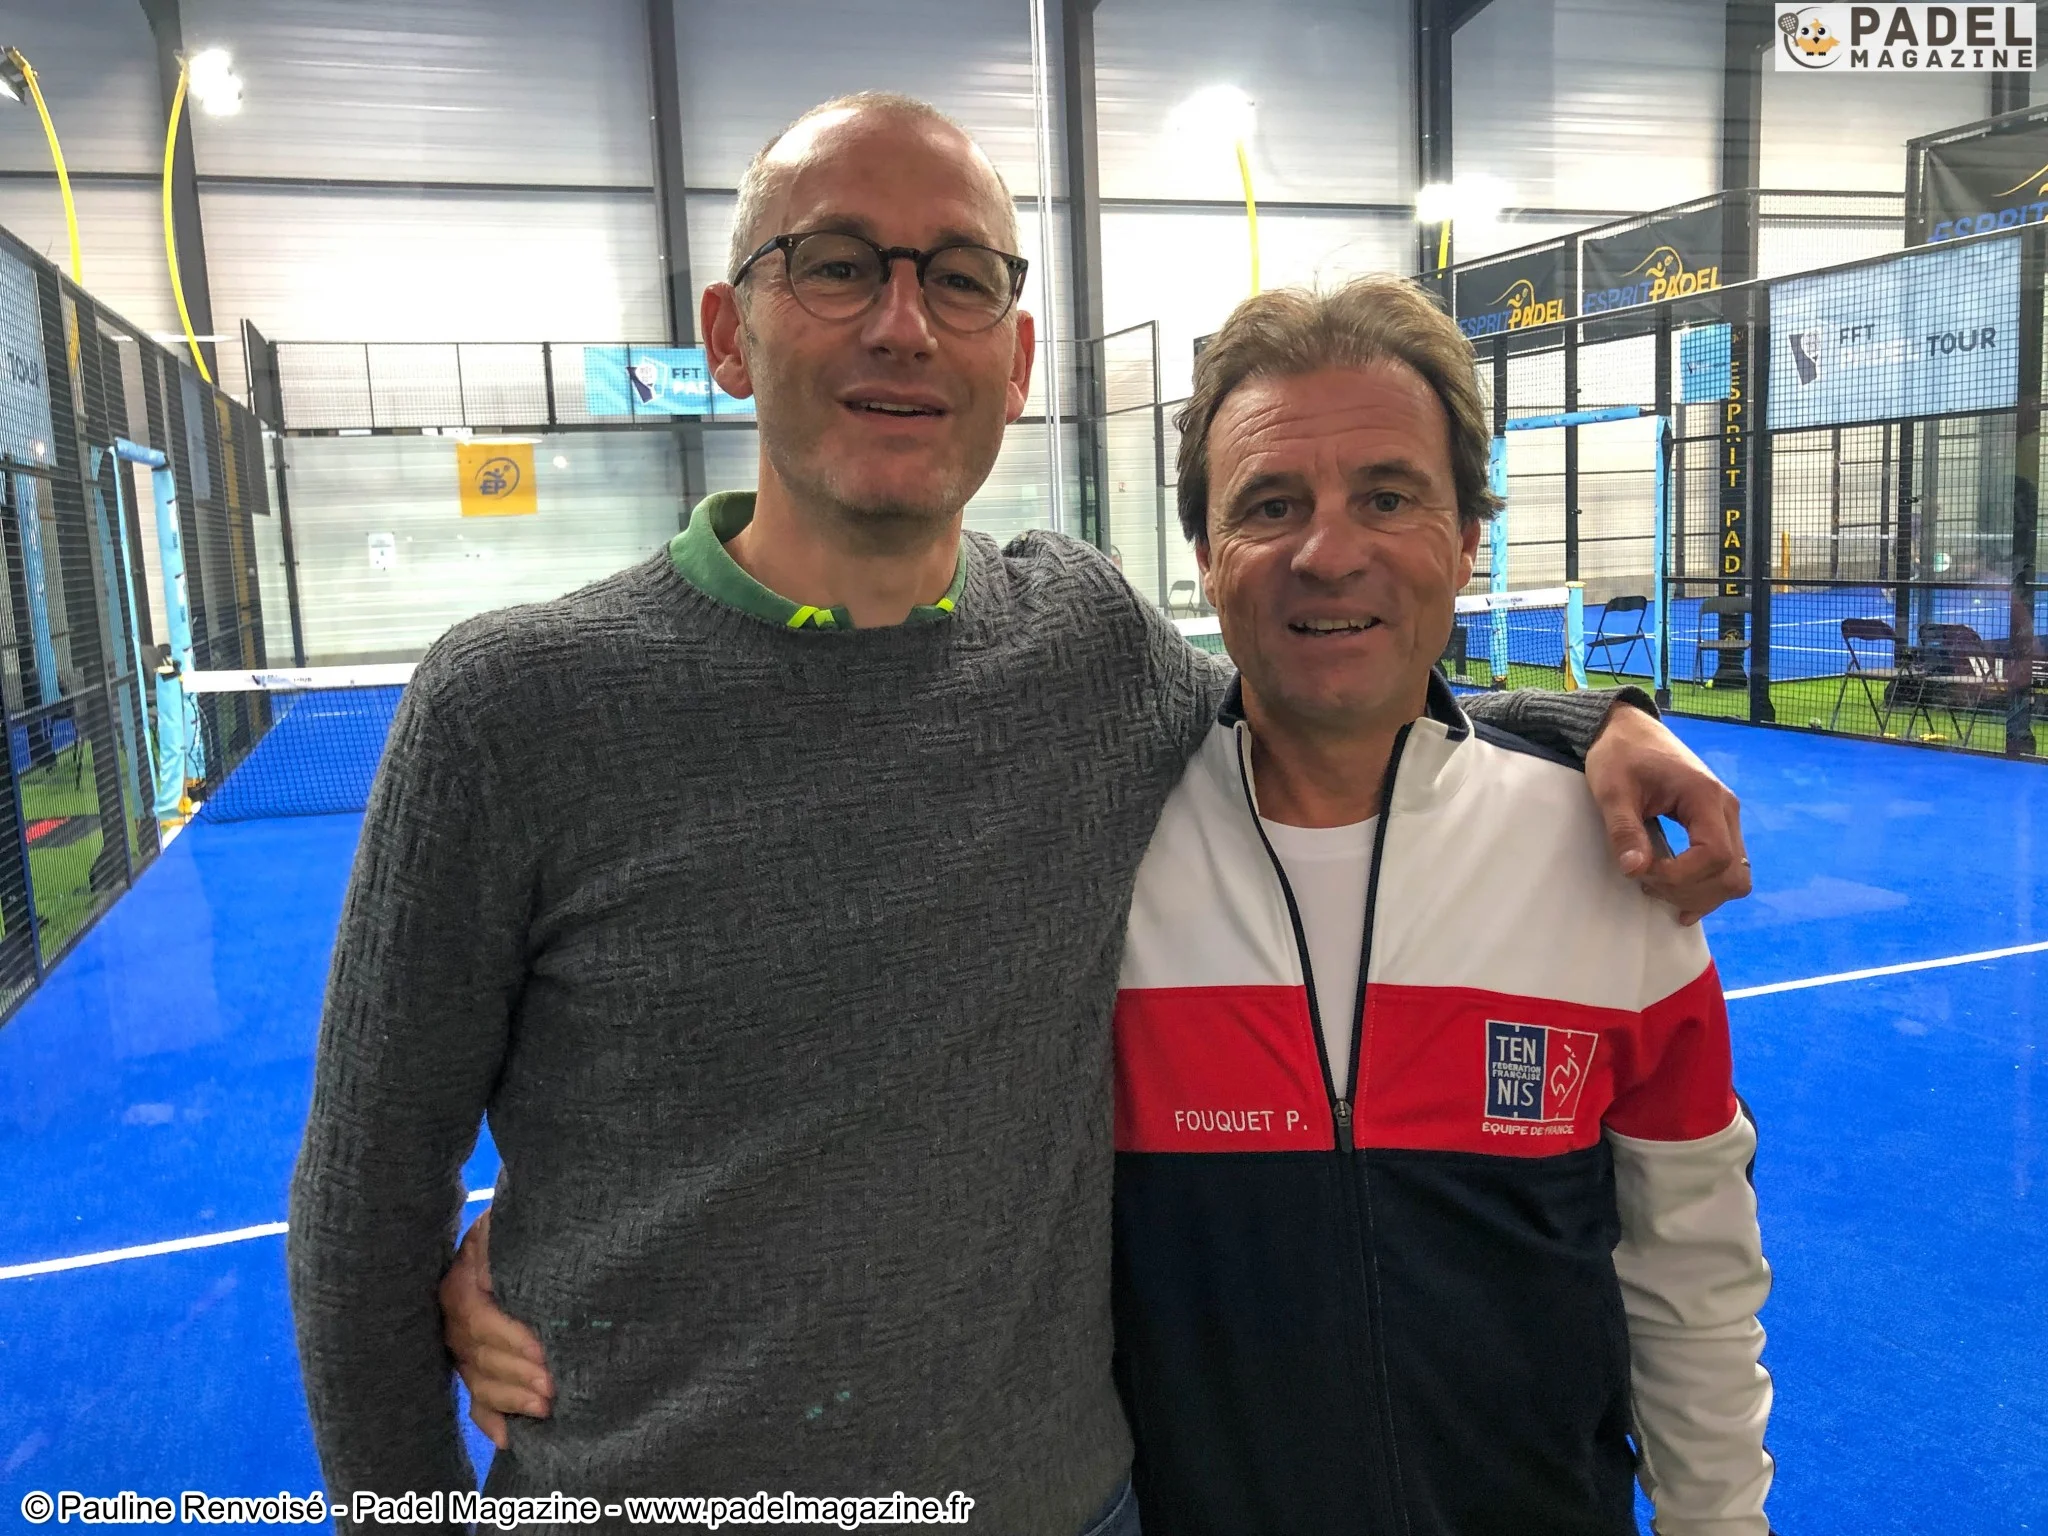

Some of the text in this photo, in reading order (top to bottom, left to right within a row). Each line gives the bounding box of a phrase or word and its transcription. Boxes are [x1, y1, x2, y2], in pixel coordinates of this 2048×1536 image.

[1648, 266, 1722, 302] PADEL
[1507, 299, 1566, 331] PADEL
[1839, 323, 1876, 345] FFT
[1926, 327, 1997, 357] TOUR
[672, 367, 701, 379] FFT
[1724, 509, 1741, 595] PADE
[1496, 1035, 1537, 1065] TEN
[1497, 1078, 1535, 1107] NIS
[1174, 1110, 1308, 1133] FOUQUET P.
[1530, 1126, 1544, 1136] DE
